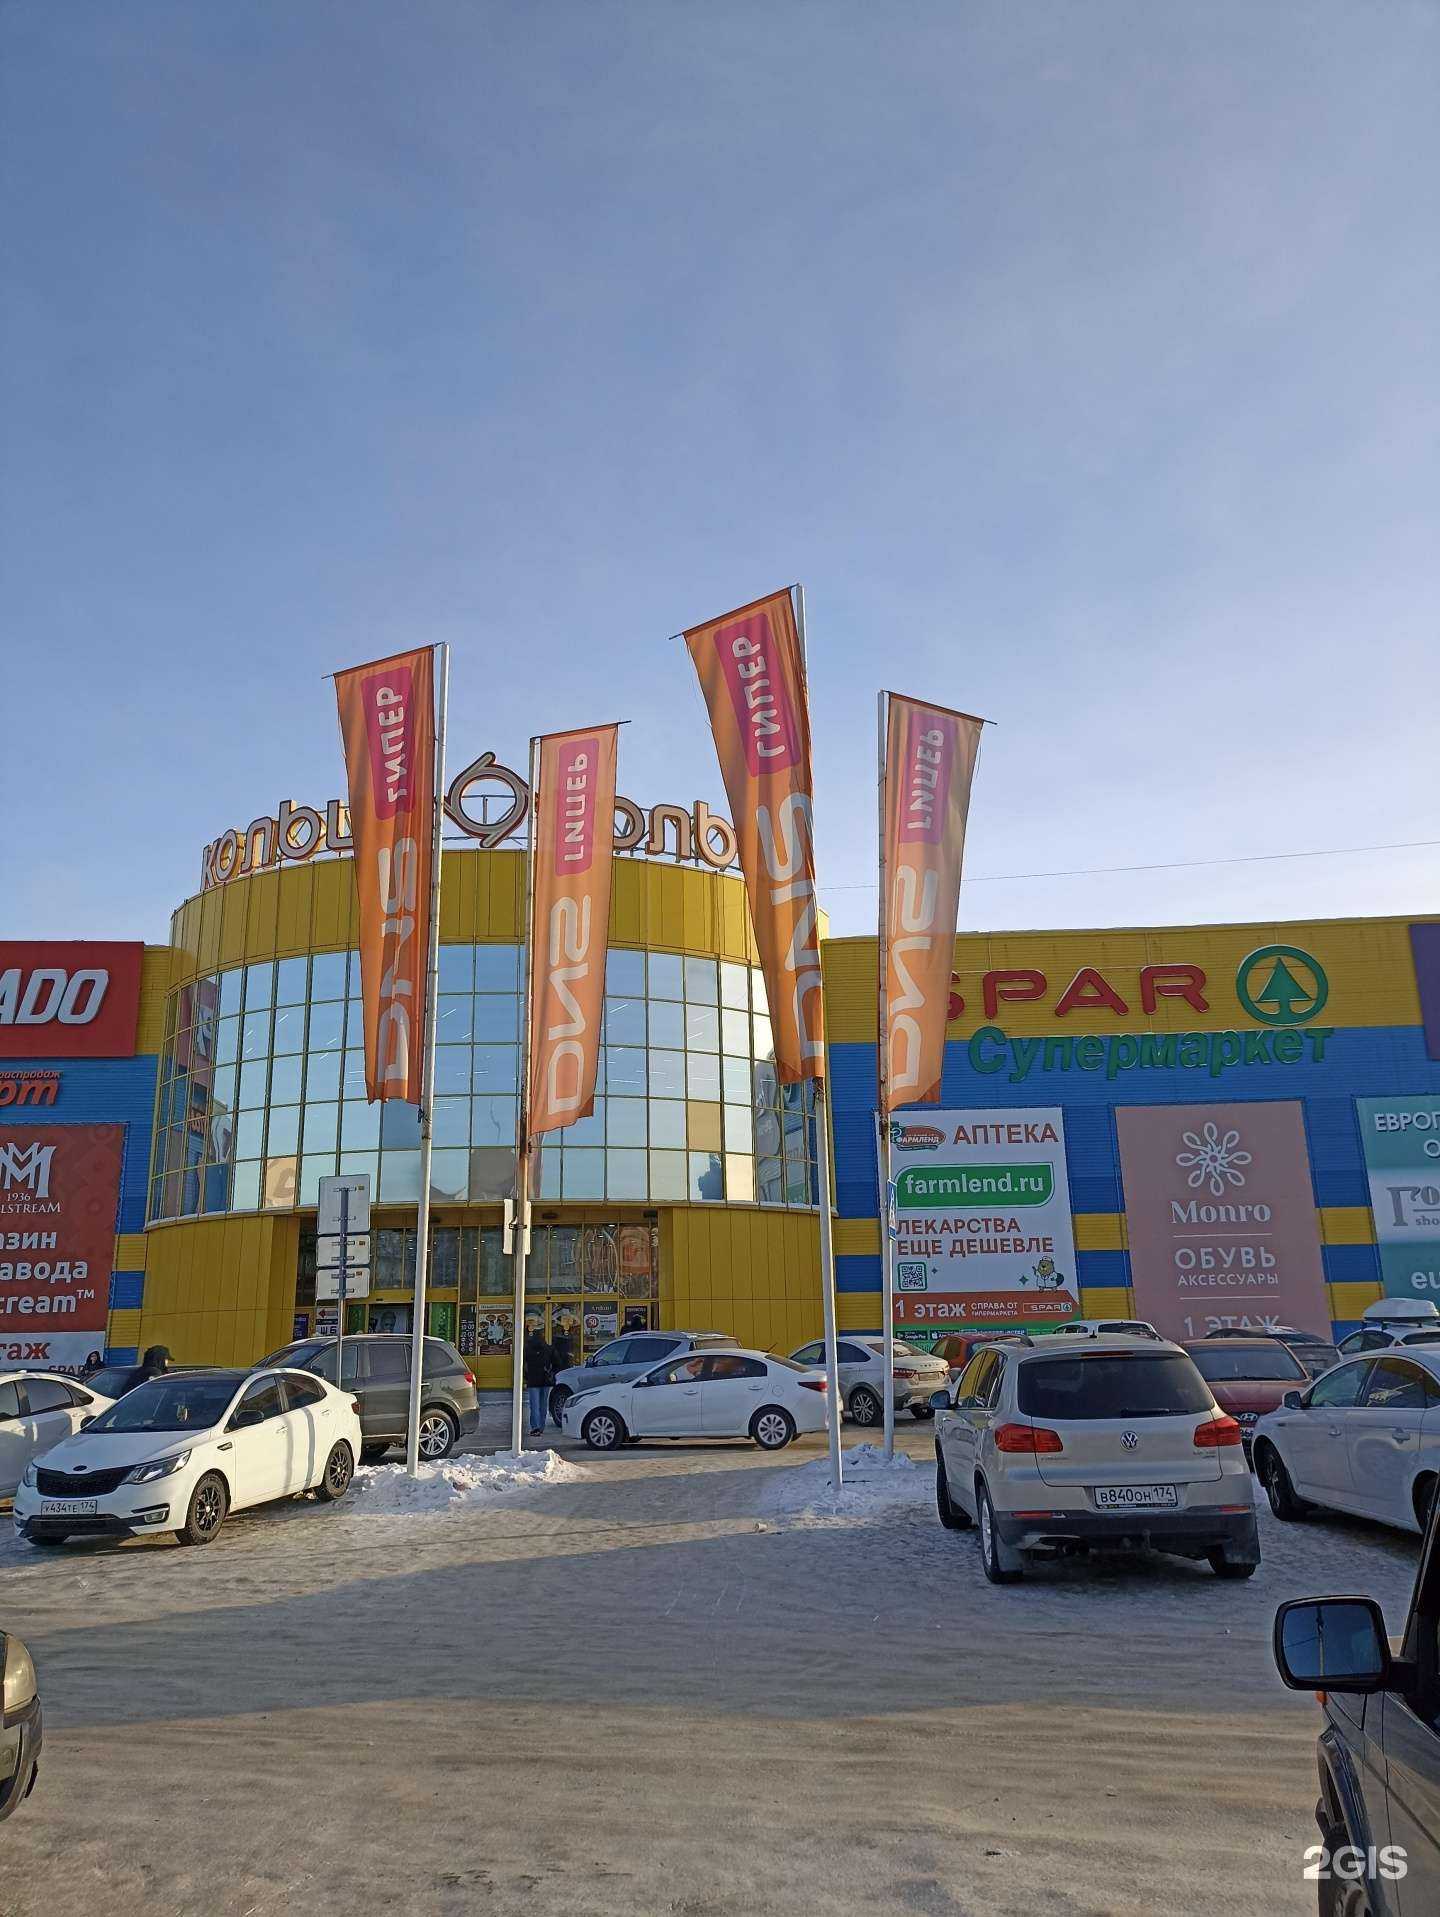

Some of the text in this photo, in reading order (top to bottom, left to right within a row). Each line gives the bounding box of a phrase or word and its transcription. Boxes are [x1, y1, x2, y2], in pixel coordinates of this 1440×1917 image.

[732, 635, 785, 758] ГИПЕР
[376, 686, 408, 804] ГИПЕР
[968, 1026, 1335, 1083] Супермаркет
[953, 1123, 1059, 1145] АПТЕКА
[905, 1172, 1044, 1194] farmlend.ru
[7, 1192, 31, 1202] 1936
[1170, 1200, 1272, 1224] Monro
[896, 1217, 1022, 1235] ЛЕКАРСТВА
[897, 1237, 1054, 1258] ЕЩЕ ДЕШЕВЛЕ
[1174, 1246, 1276, 1270] ОБУВЬ
[1177, 1273, 1279, 1287] АКСЕССУАРЫ
[895, 1299, 967, 1318] 1 этаж
[970, 1302, 1005, 1310] СПРАВА
[1184, 1316, 1194, 1337] 1
